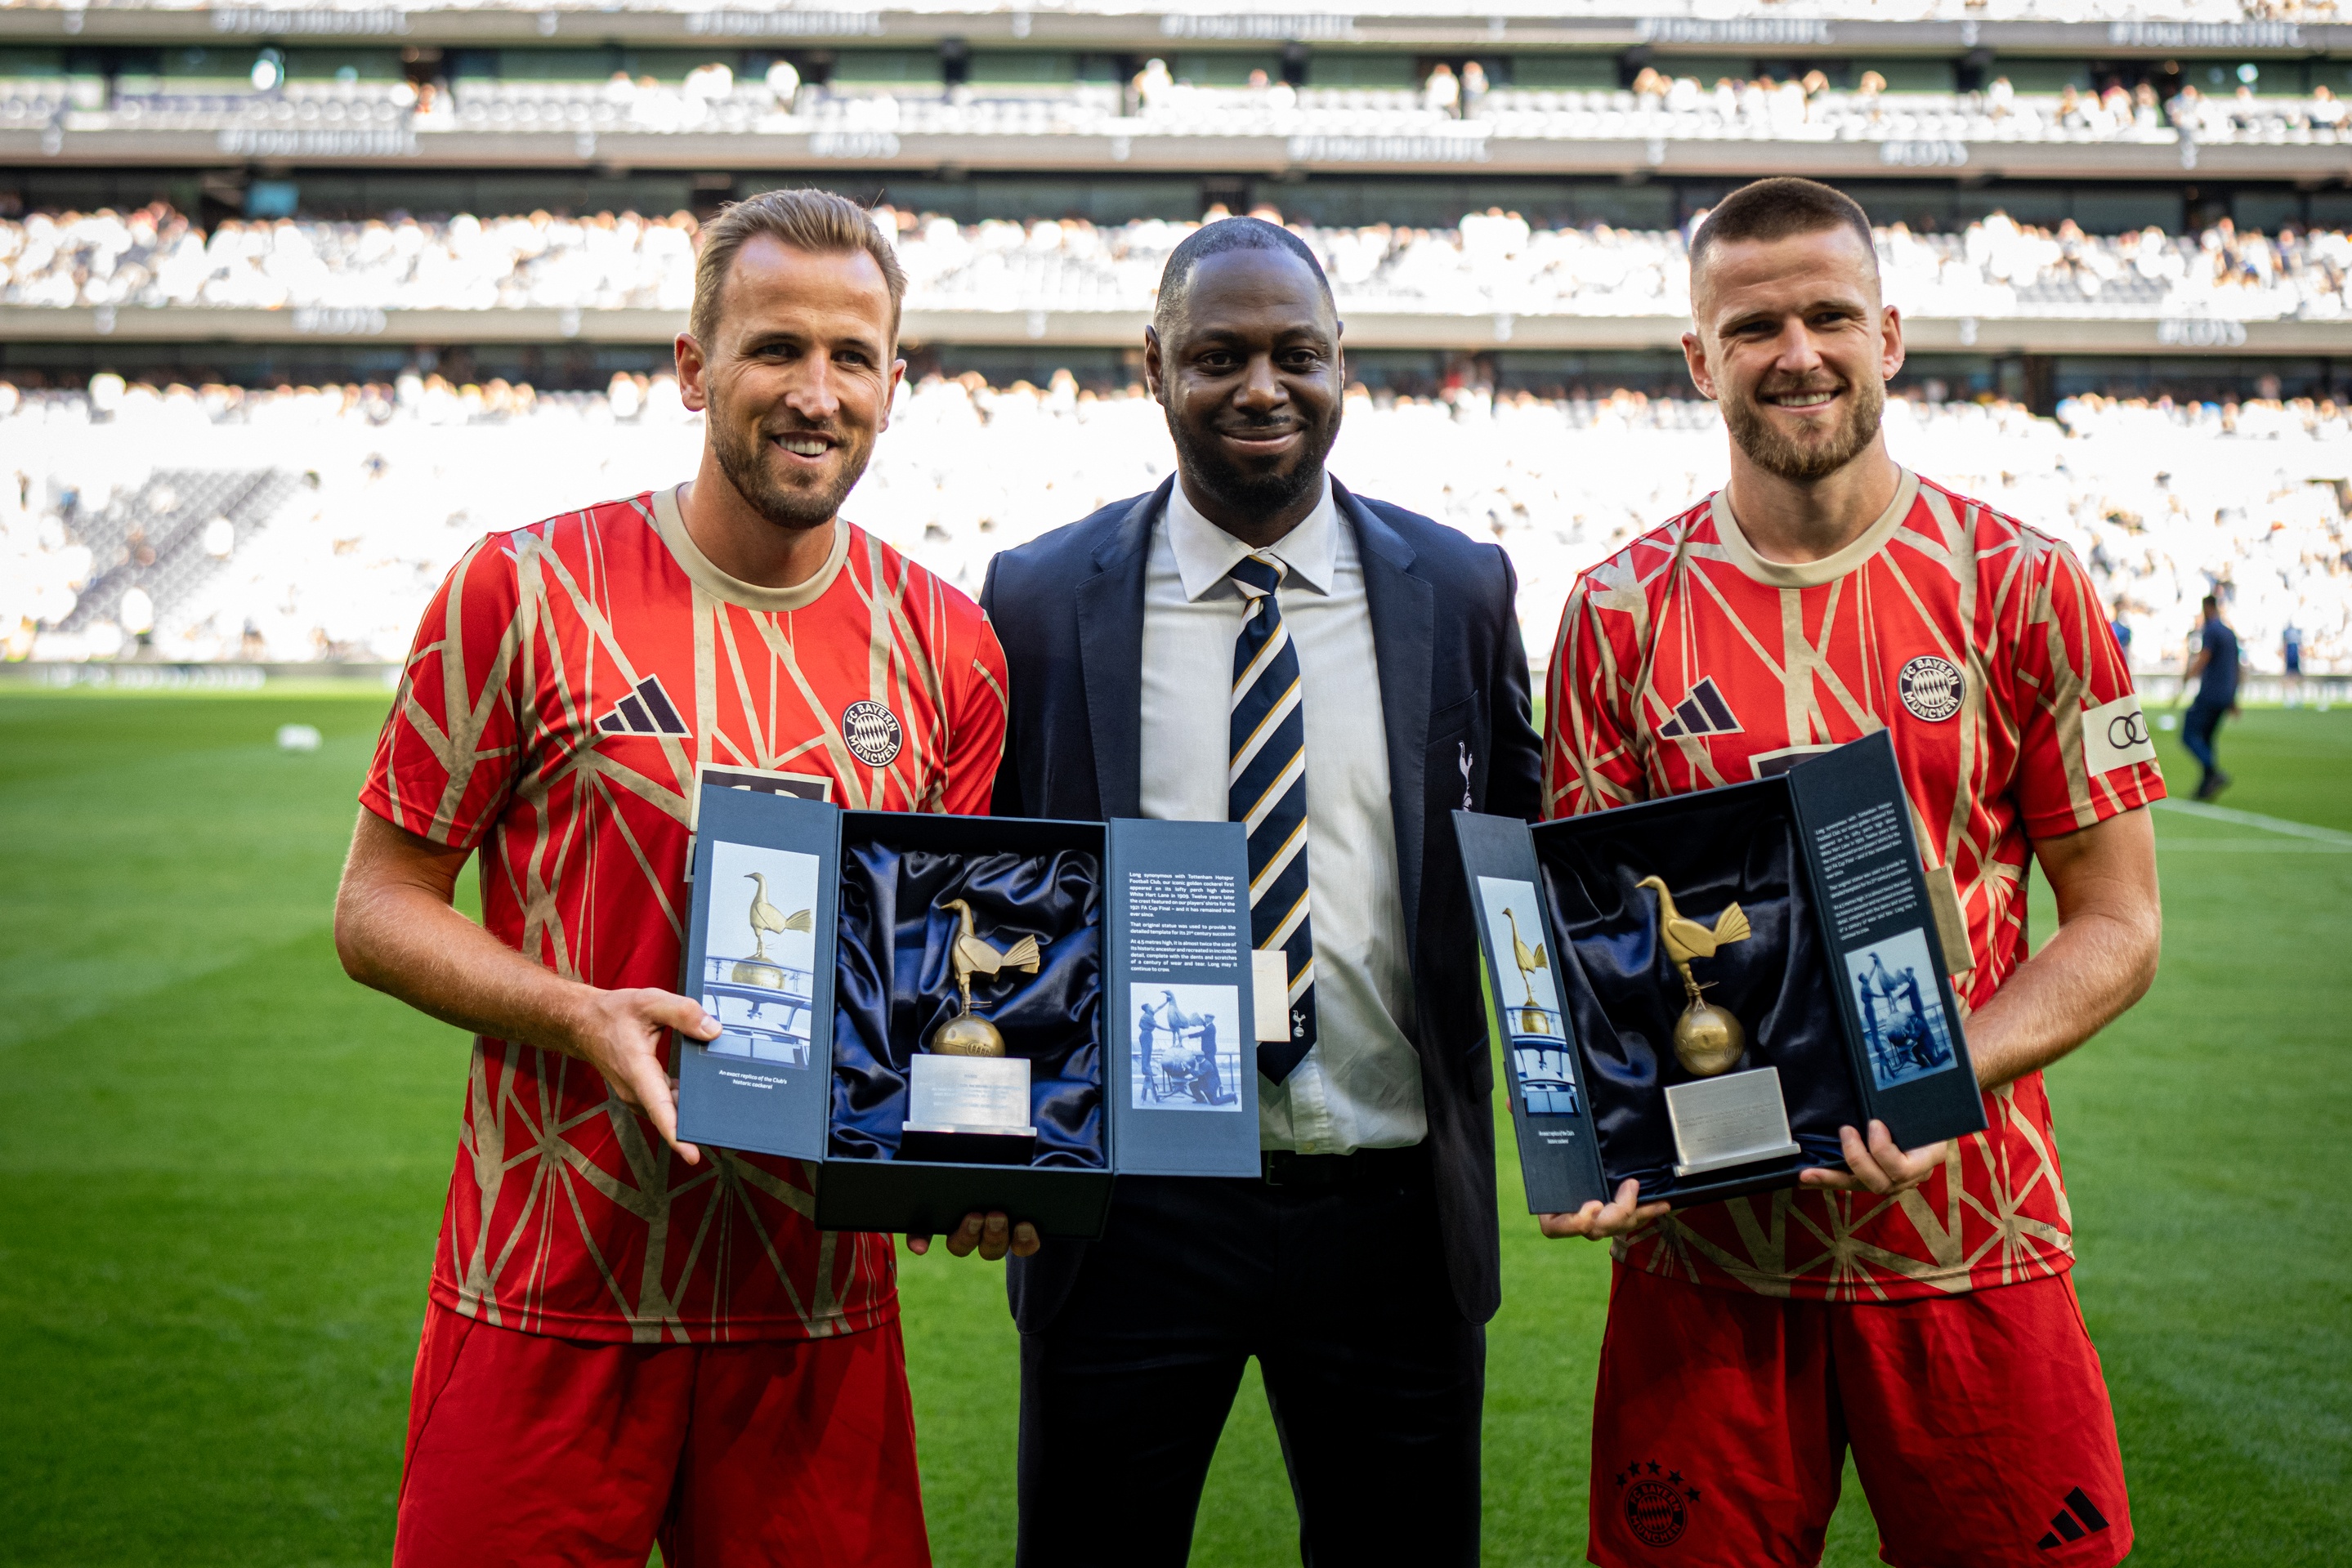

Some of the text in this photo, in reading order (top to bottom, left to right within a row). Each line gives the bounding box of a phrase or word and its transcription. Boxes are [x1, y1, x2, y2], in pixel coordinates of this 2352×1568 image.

[1903, 659, 1959, 686] FC BAYERN
[847, 704, 897, 731] FC BAYERN
[1630, 1485, 1681, 1512] FC BAYERN
